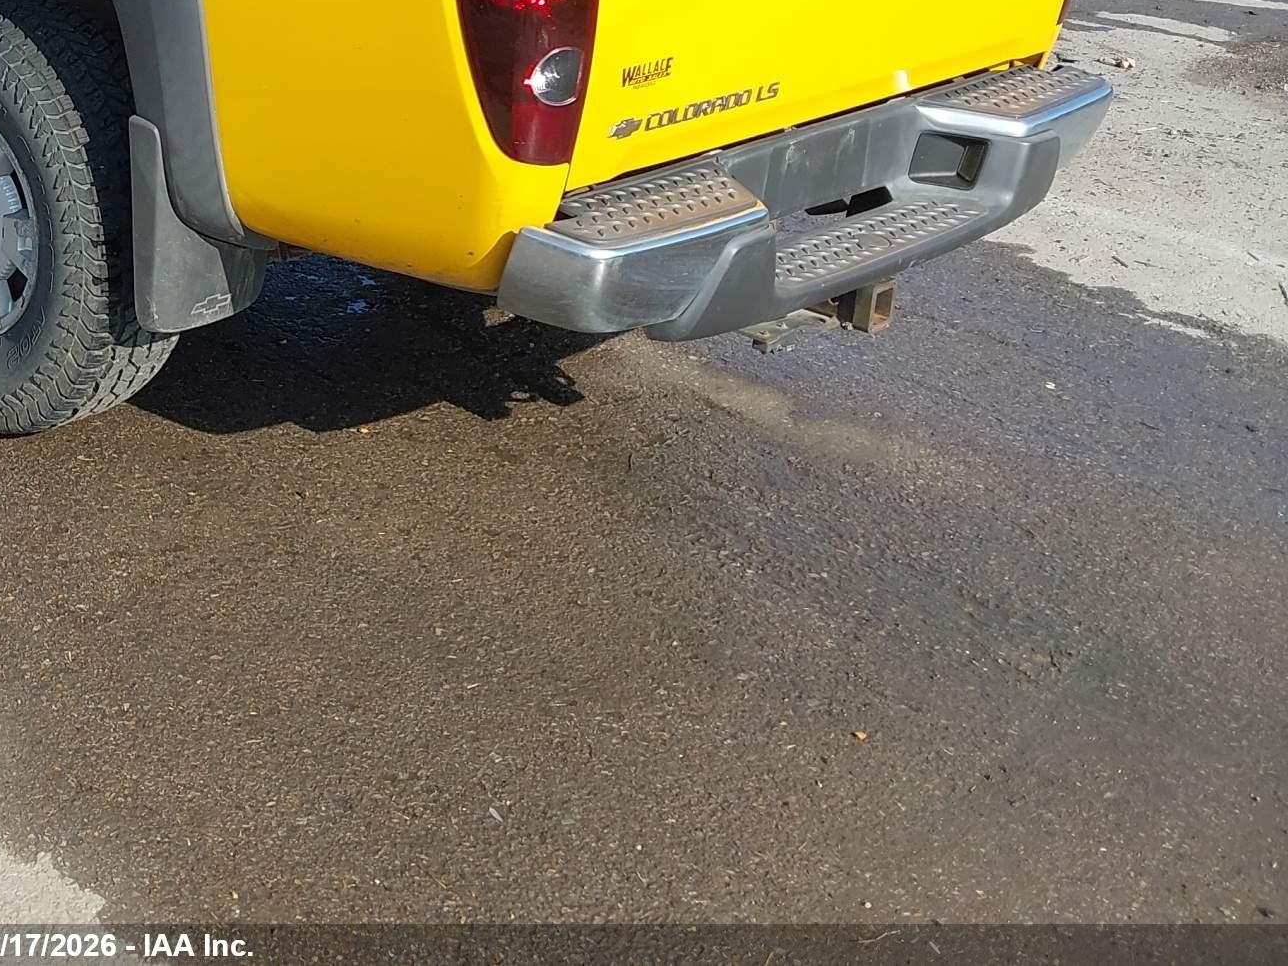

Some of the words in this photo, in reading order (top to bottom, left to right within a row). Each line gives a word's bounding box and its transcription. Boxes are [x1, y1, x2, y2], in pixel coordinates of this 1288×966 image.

[622, 57, 673, 87] WALLACE
[644, 89, 752, 131] COLORADO
[756, 82, 781, 102] LS
